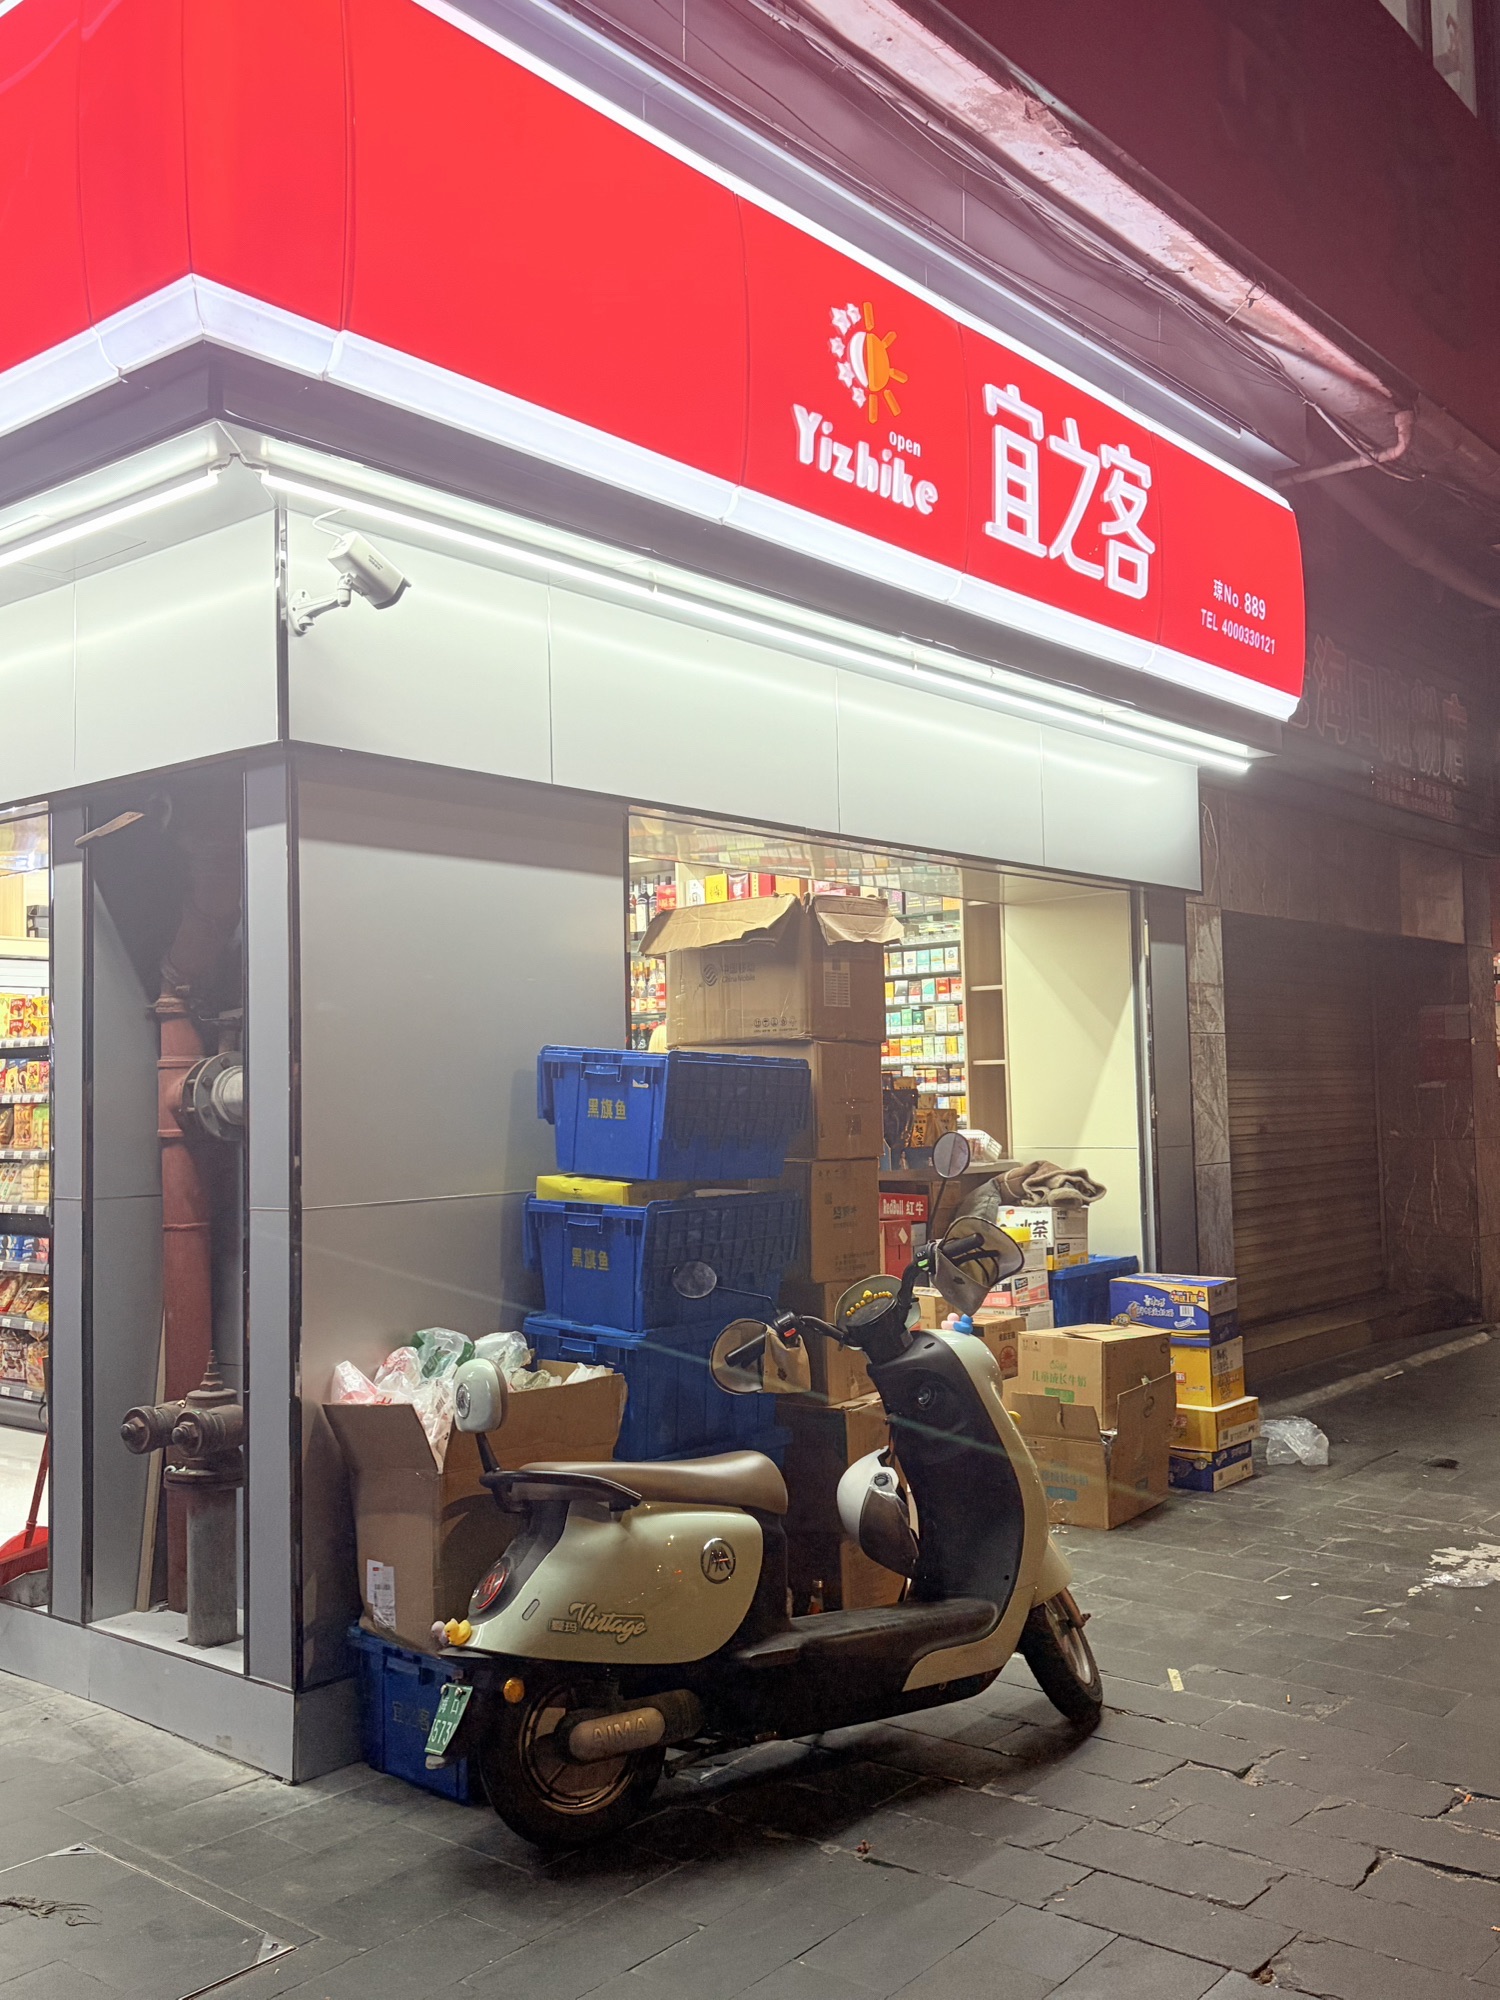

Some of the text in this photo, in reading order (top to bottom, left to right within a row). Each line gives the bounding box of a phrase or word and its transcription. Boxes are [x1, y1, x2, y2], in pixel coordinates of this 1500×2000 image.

[889, 431, 921, 457] open
[793, 404, 938, 515] Yizhike
[983, 383, 1155, 600] 宜之客
[1244, 592, 1266, 621] 889
[1200, 608, 1276, 655] TEL 4000330121
[587, 1098, 627, 1120] 黑旗鱼
[883, 1198, 925, 1216] RedBull 红牛
[572, 1247, 609, 1271] 黑旗鱼
[569, 1602, 647, 1644] Vintage
[593, 1716, 647, 1743] AIMA
